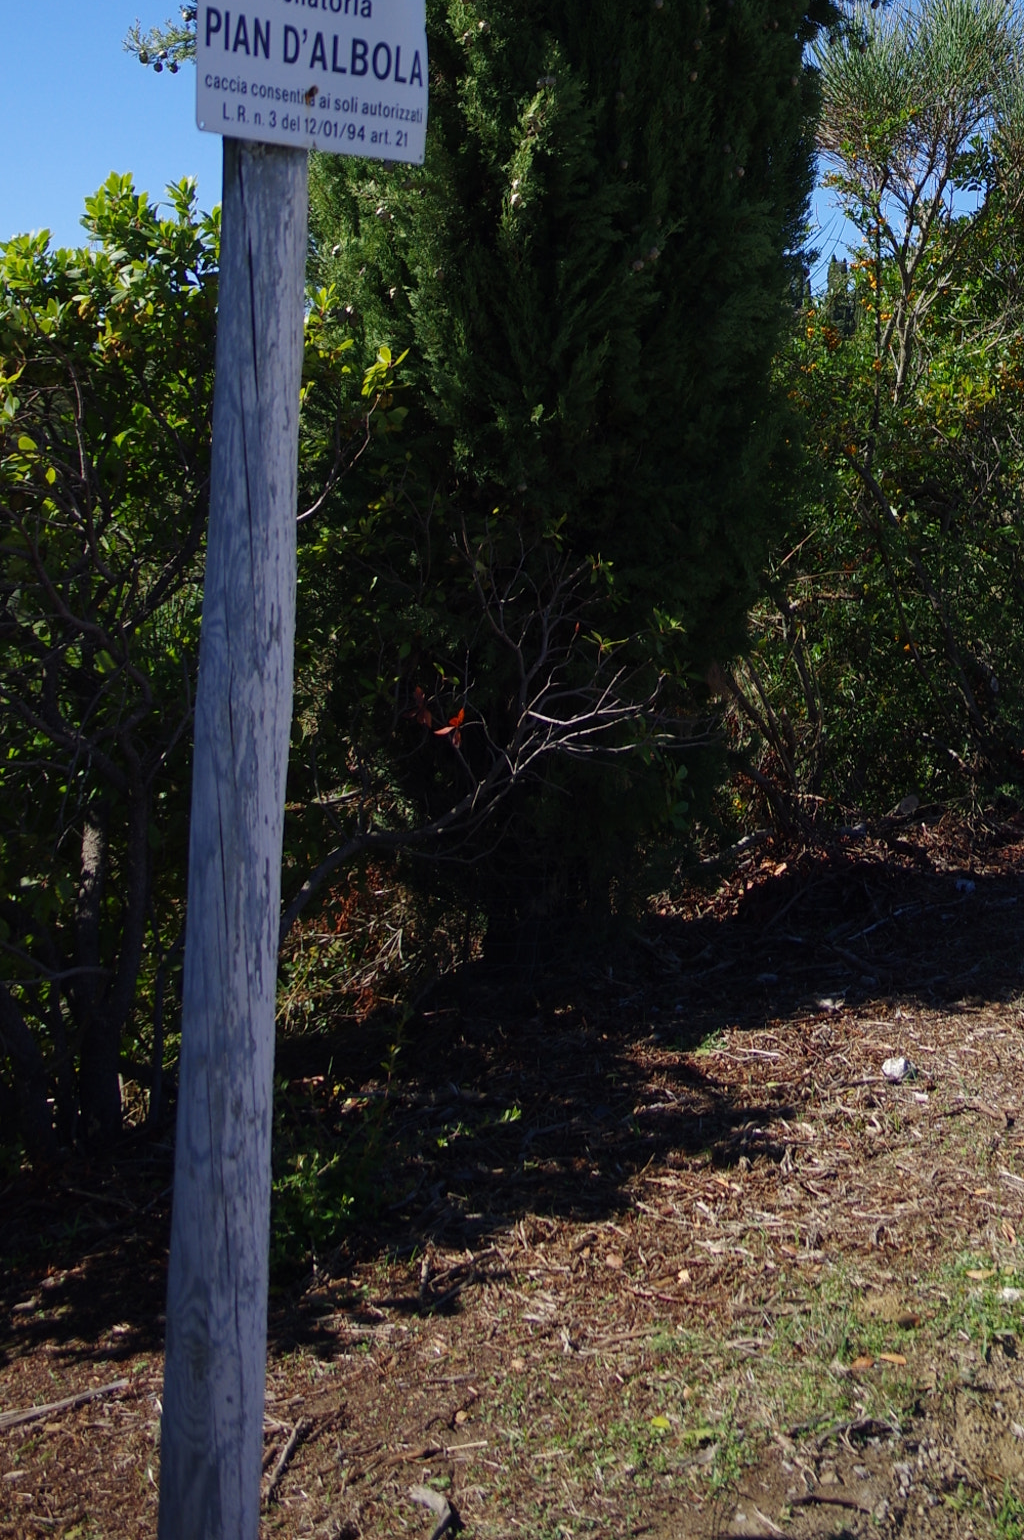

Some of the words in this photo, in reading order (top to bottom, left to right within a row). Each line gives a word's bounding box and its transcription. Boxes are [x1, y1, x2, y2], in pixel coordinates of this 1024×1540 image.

[205, 7, 271, 60] PIAN
[283, 24, 424, 88] D'ALBOLA
[205, 74, 248, 95] caccia
[319, 93, 331, 110] ai
[334, 96, 359, 114] soli
[362, 102, 423, 124] autorizzati
[254, 112, 265, 126] n.
[269, 110, 277, 128] 3
[281, 113, 301, 132] del
[305, 118, 366, 142] 12/01/94
[370, 129, 392, 146] art.
[396, 130, 408, 148] 21
